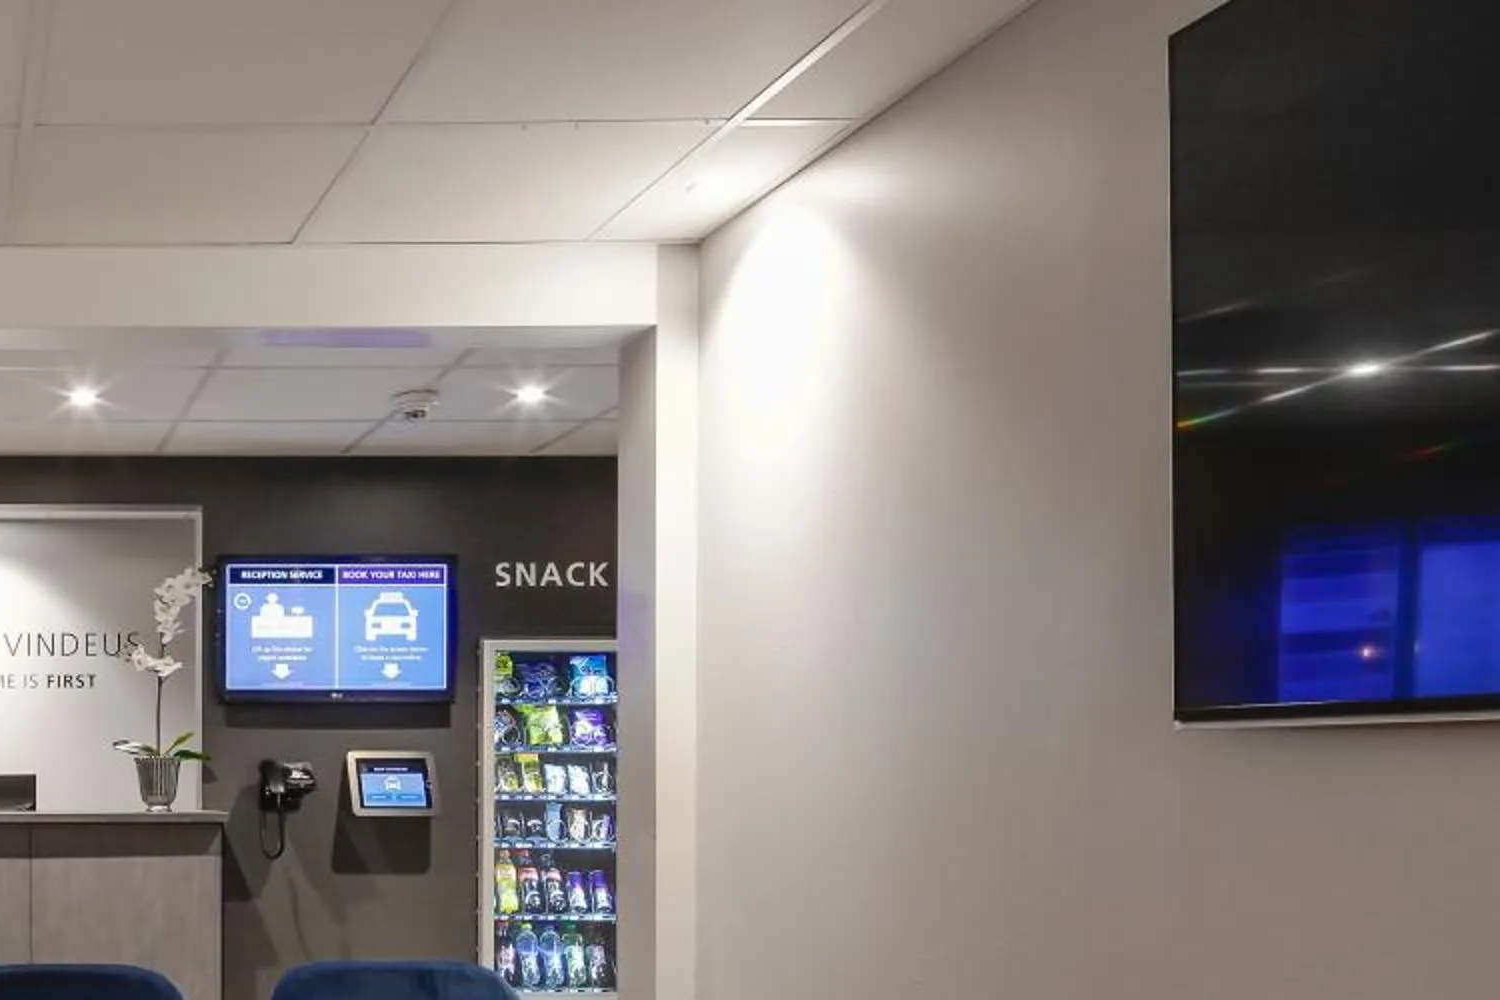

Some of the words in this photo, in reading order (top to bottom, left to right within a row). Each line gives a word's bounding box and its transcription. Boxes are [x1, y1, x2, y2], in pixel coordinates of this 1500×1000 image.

[290, 570, 323, 580] SERVICE
[342, 570, 369, 580] BOOK
[371, 570, 395, 580] YOUR
[495, 561, 609, 587] SNACK
[23, 674, 39, 688] IS
[46, 673, 97, 688] FIRST
